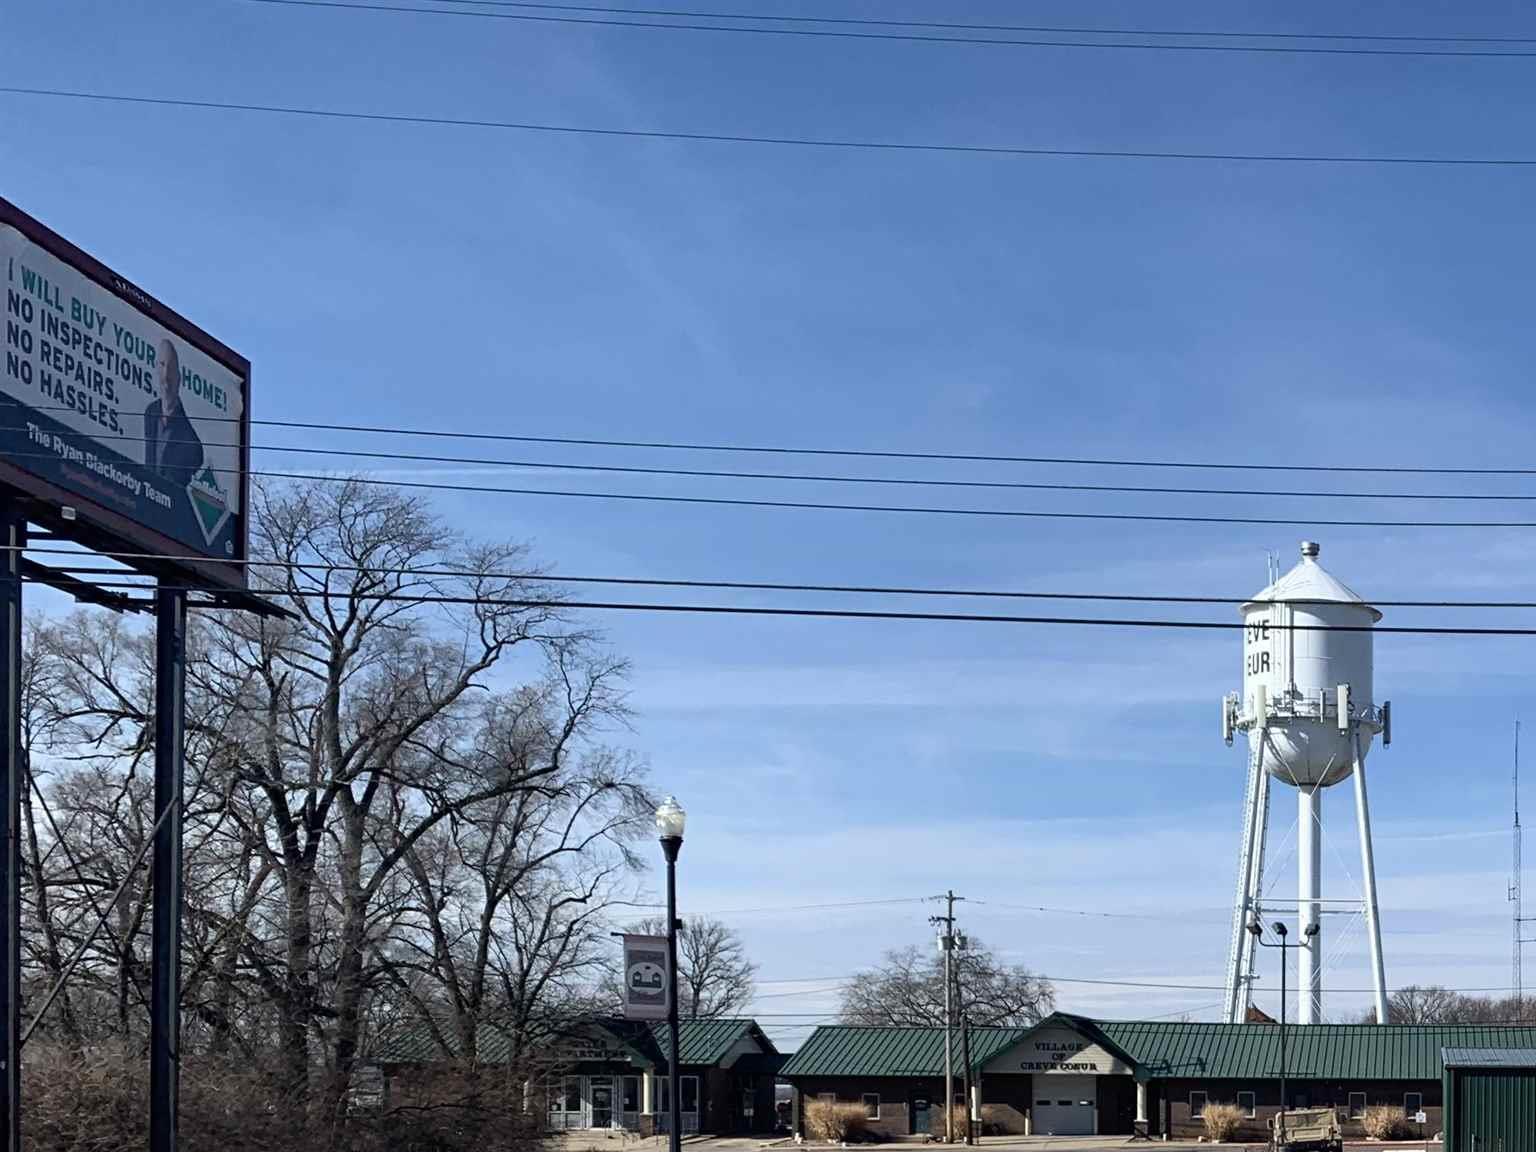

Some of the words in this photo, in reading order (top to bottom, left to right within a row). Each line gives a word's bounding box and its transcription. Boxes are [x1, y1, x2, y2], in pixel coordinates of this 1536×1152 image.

[7, 319, 33, 354] NO
[40, 339, 120, 404] REPAIRS.
[8, 257, 13, 281] I
[21, 264, 65, 313] WILL
[71, 297, 107, 337] BUY
[113, 323, 156, 369] YOUR
[181, 365, 228, 412] HOME!
[8, 288, 33, 323] NO
[40, 309, 158, 398] INSPECTIONS.
[7, 351, 33, 385] NO
[40, 369, 124, 435] HASSLES.
[26, 422, 50, 448] The
[53, 435, 84, 465] Ryan
[85, 451, 142, 496] Blackorby
[143, 481, 172, 509] Team
[1248, 619, 1270, 644] VE
[1248, 651, 1270, 676] UR
[1034, 1042, 1083, 1051] VILLAGE
[1052, 1053, 1066, 1061] OF
